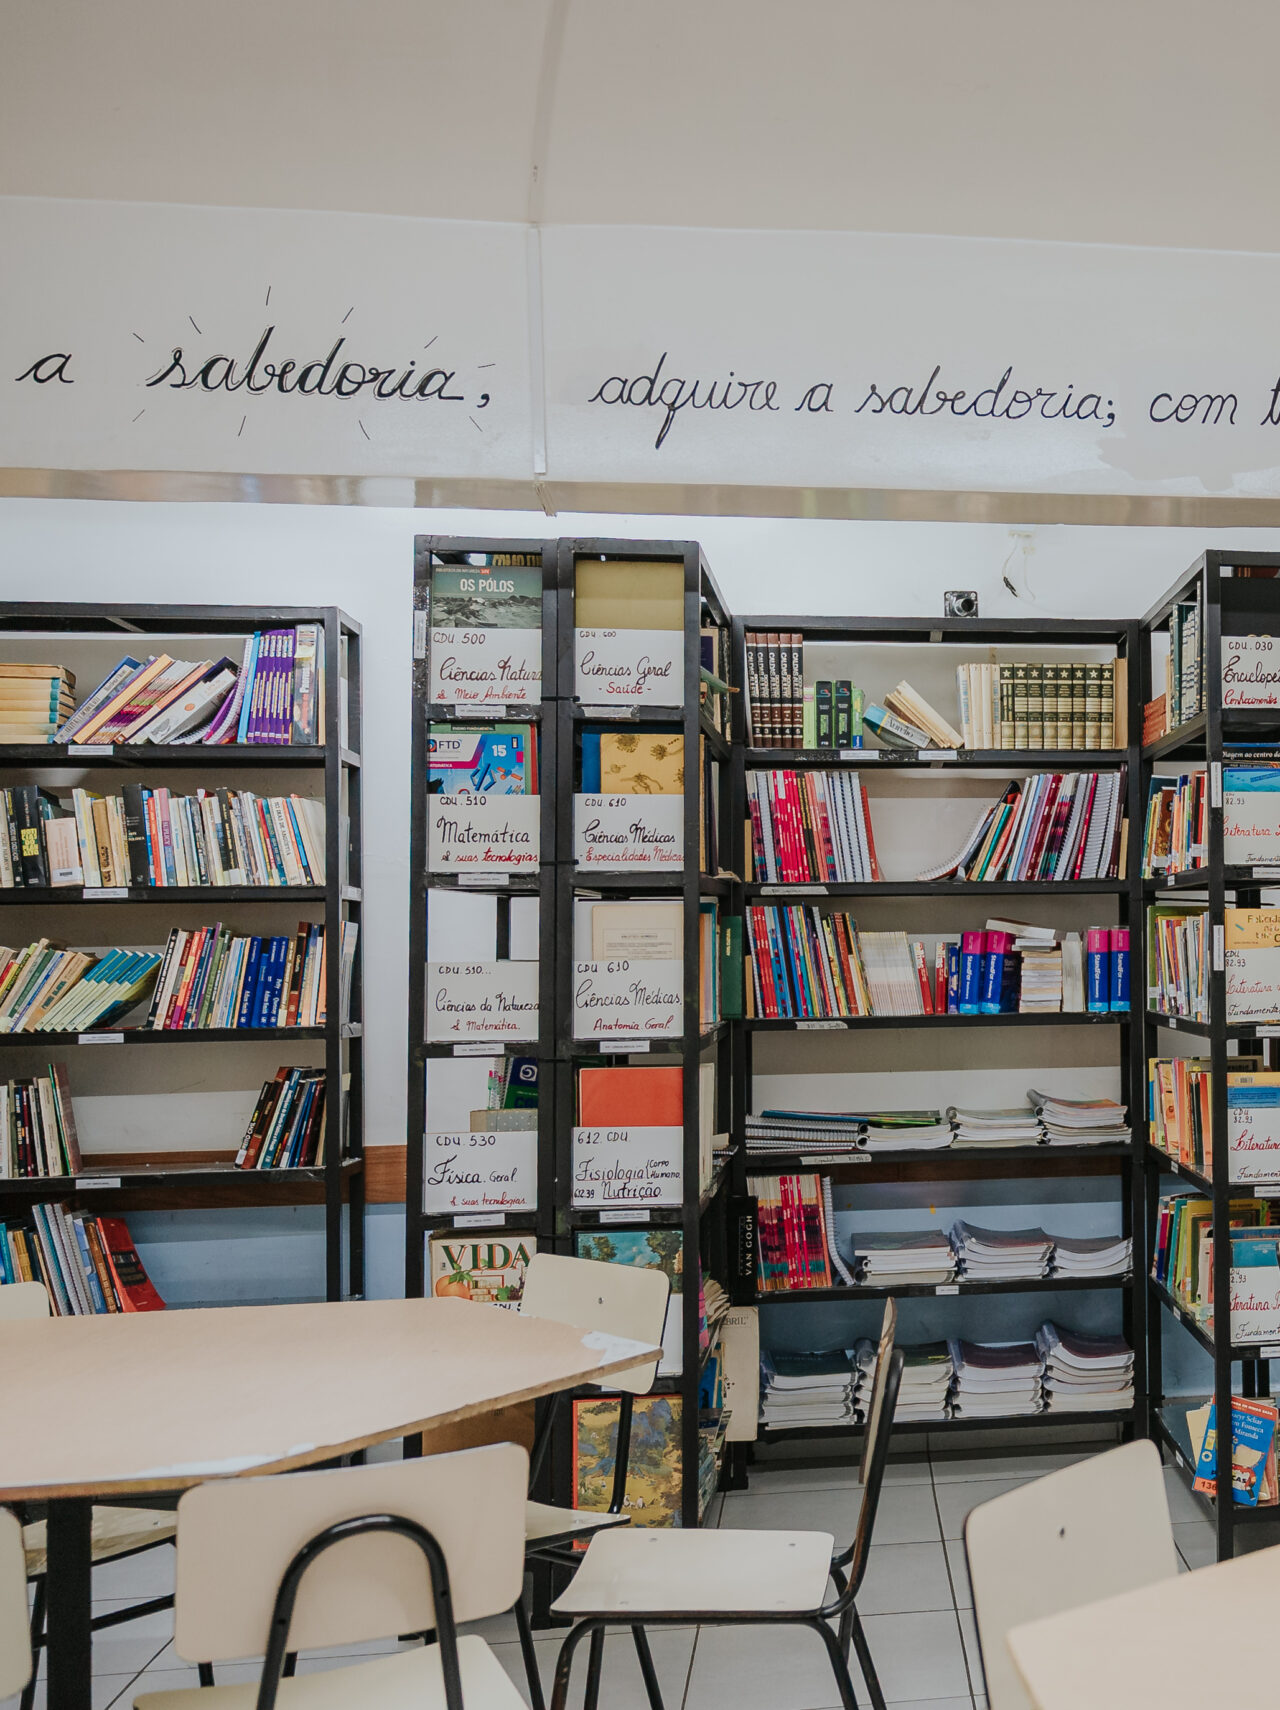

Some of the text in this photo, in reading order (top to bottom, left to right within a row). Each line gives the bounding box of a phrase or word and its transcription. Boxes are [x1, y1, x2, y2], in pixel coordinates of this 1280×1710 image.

[15, 325, 493, 409] a sabedoria,
[588, 352, 781, 450] adquire
[795, 382, 834, 413] a
[854, 365, 1115, 429] sabedoria;
[1149, 392, 1238, 426] com
[460, 578, 514, 593] OS PÓLOS
[461, 633, 486, 645] 500
[1255, 641, 1272, 651] 030
[440, 656, 496, 681] Ciências
[580, 650, 672, 686] Ciências Geral
[455, 685, 527, 702] Meio Ambiente
[438, 740, 461, 750] FTD
[492, 744, 507, 757] 15
[466, 796, 487, 806] 510
[608, 798, 627, 808] 610
[437, 816, 530, 844] Matemática
[582, 818, 676, 844] Ciências Médicas
[482, 847, 539, 865] tecnologias
[577, 960, 630, 973] CDU 610
[436, 988, 477, 1012] Ciências
[480, 997, 492, 1012] da
[576, 979, 630, 1008] Ciências
[468, 1135, 496, 1147] 530
[575, 1157, 644, 1183] Fisiologia
[745, 1215, 753, 1276] VAN GOGH
[442, 1243, 531, 1270] VIDA
